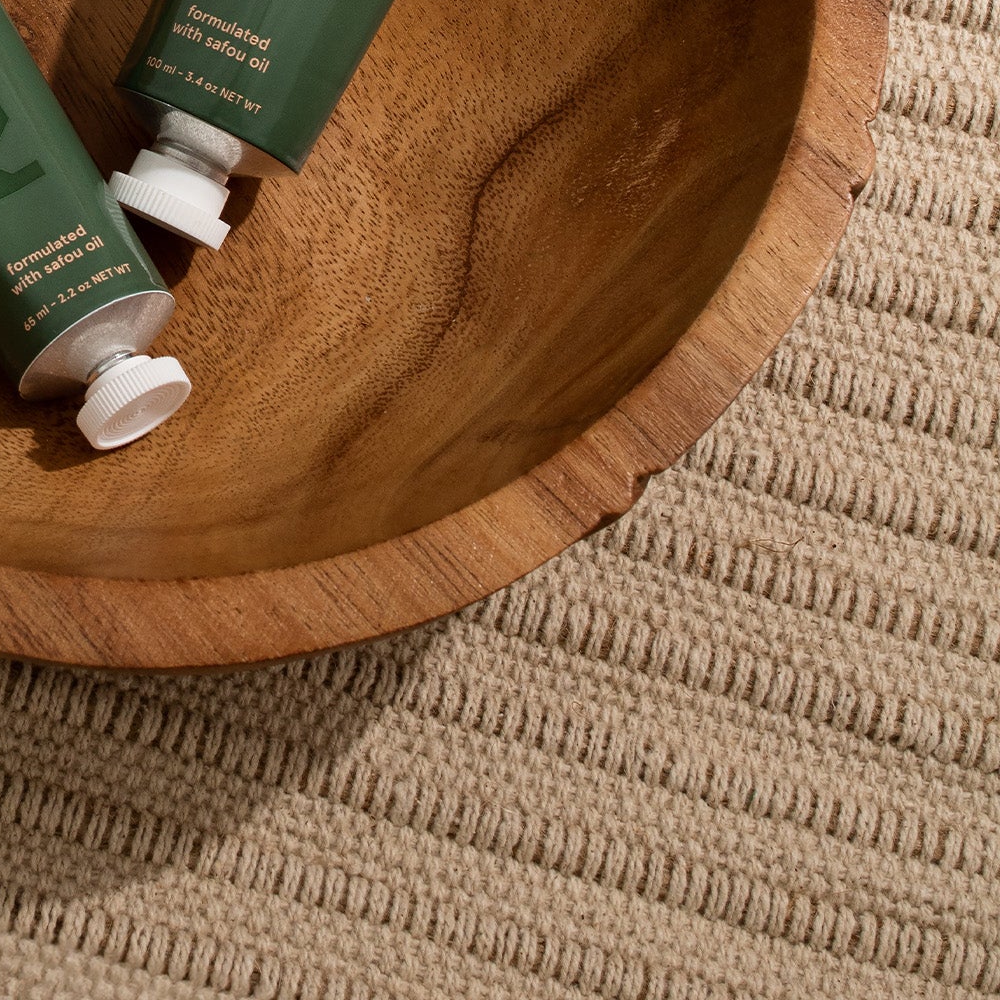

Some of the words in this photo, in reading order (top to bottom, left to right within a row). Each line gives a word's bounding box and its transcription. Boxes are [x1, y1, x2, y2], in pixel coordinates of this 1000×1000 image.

[172, 22, 203, 43] with
[205, 36, 247, 62] safou
[249, 57, 271, 74] oil
[187, 4, 272, 51] formulated
[146, 56, 162, 69] 100
[162, 62, 177, 75] ml
[185, 71, 204, 86] 3.4
[204, 81, 218, 94] oz
[219, 87, 244, 105] NET
[243, 99, 262, 115] WT
[6, 224, 88, 276] formulated
[10, 271, 43, 297] with
[44, 247, 84, 275] safou
[85, 236, 105, 253] oil
[23, 317, 37, 332] 65
[35, 305, 50, 321] ml
[57, 287, 77, 305] 2.2
[77, 280, 92, 293] oz
[90, 268, 114, 284] NET
[114, 263, 132, 275] WT
